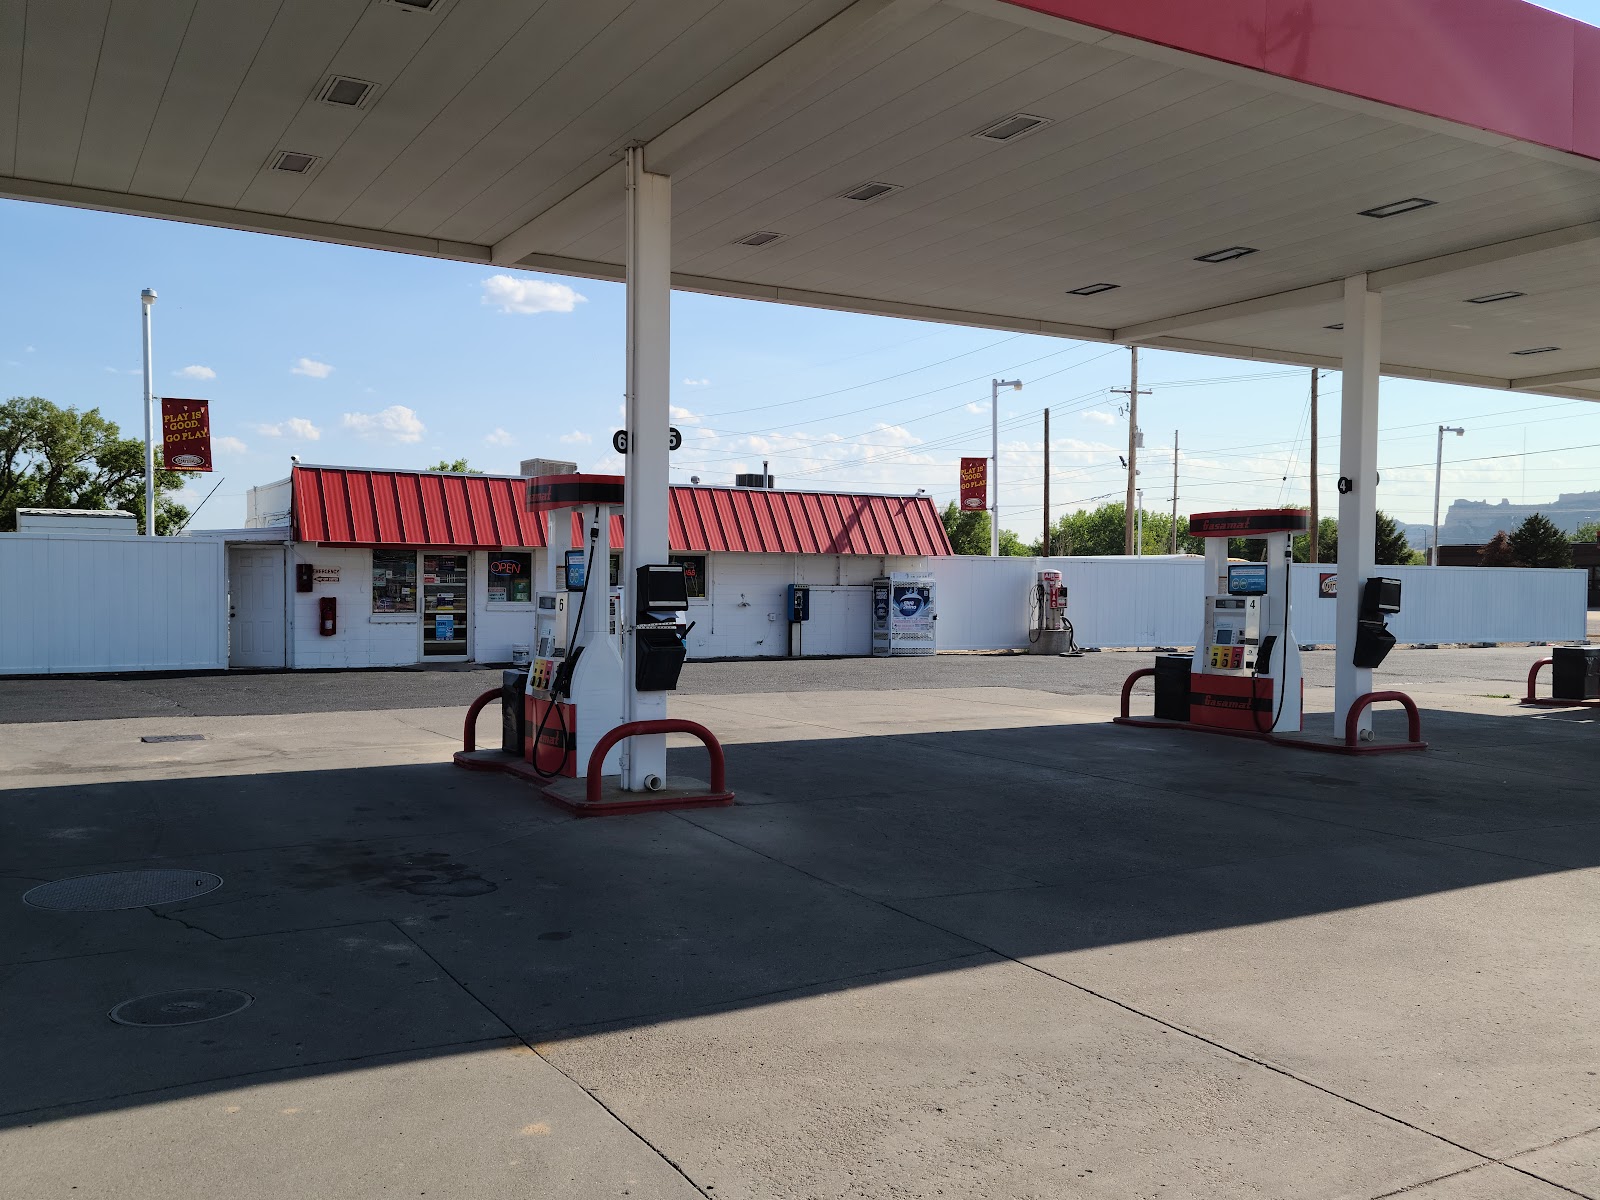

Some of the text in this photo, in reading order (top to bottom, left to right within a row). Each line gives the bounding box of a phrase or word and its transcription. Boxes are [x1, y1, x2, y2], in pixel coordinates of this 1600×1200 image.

[164, 411, 202, 423] PLAY IS
[169, 420, 200, 431] GOOD.
[165, 434, 180, 443] GO
[617, 433, 626, 450] 6
[961, 467, 976, 475] PLAY
[961, 482, 970, 490] GO
[1339, 479, 1346, 491] 4
[1202, 517, 1250, 531] Gasamat
[490, 561, 521, 574] OPEN
[559, 599, 564, 611] 6
[1249, 599, 1256, 610] 4
[1204, 695, 1253, 709] Gasamat
